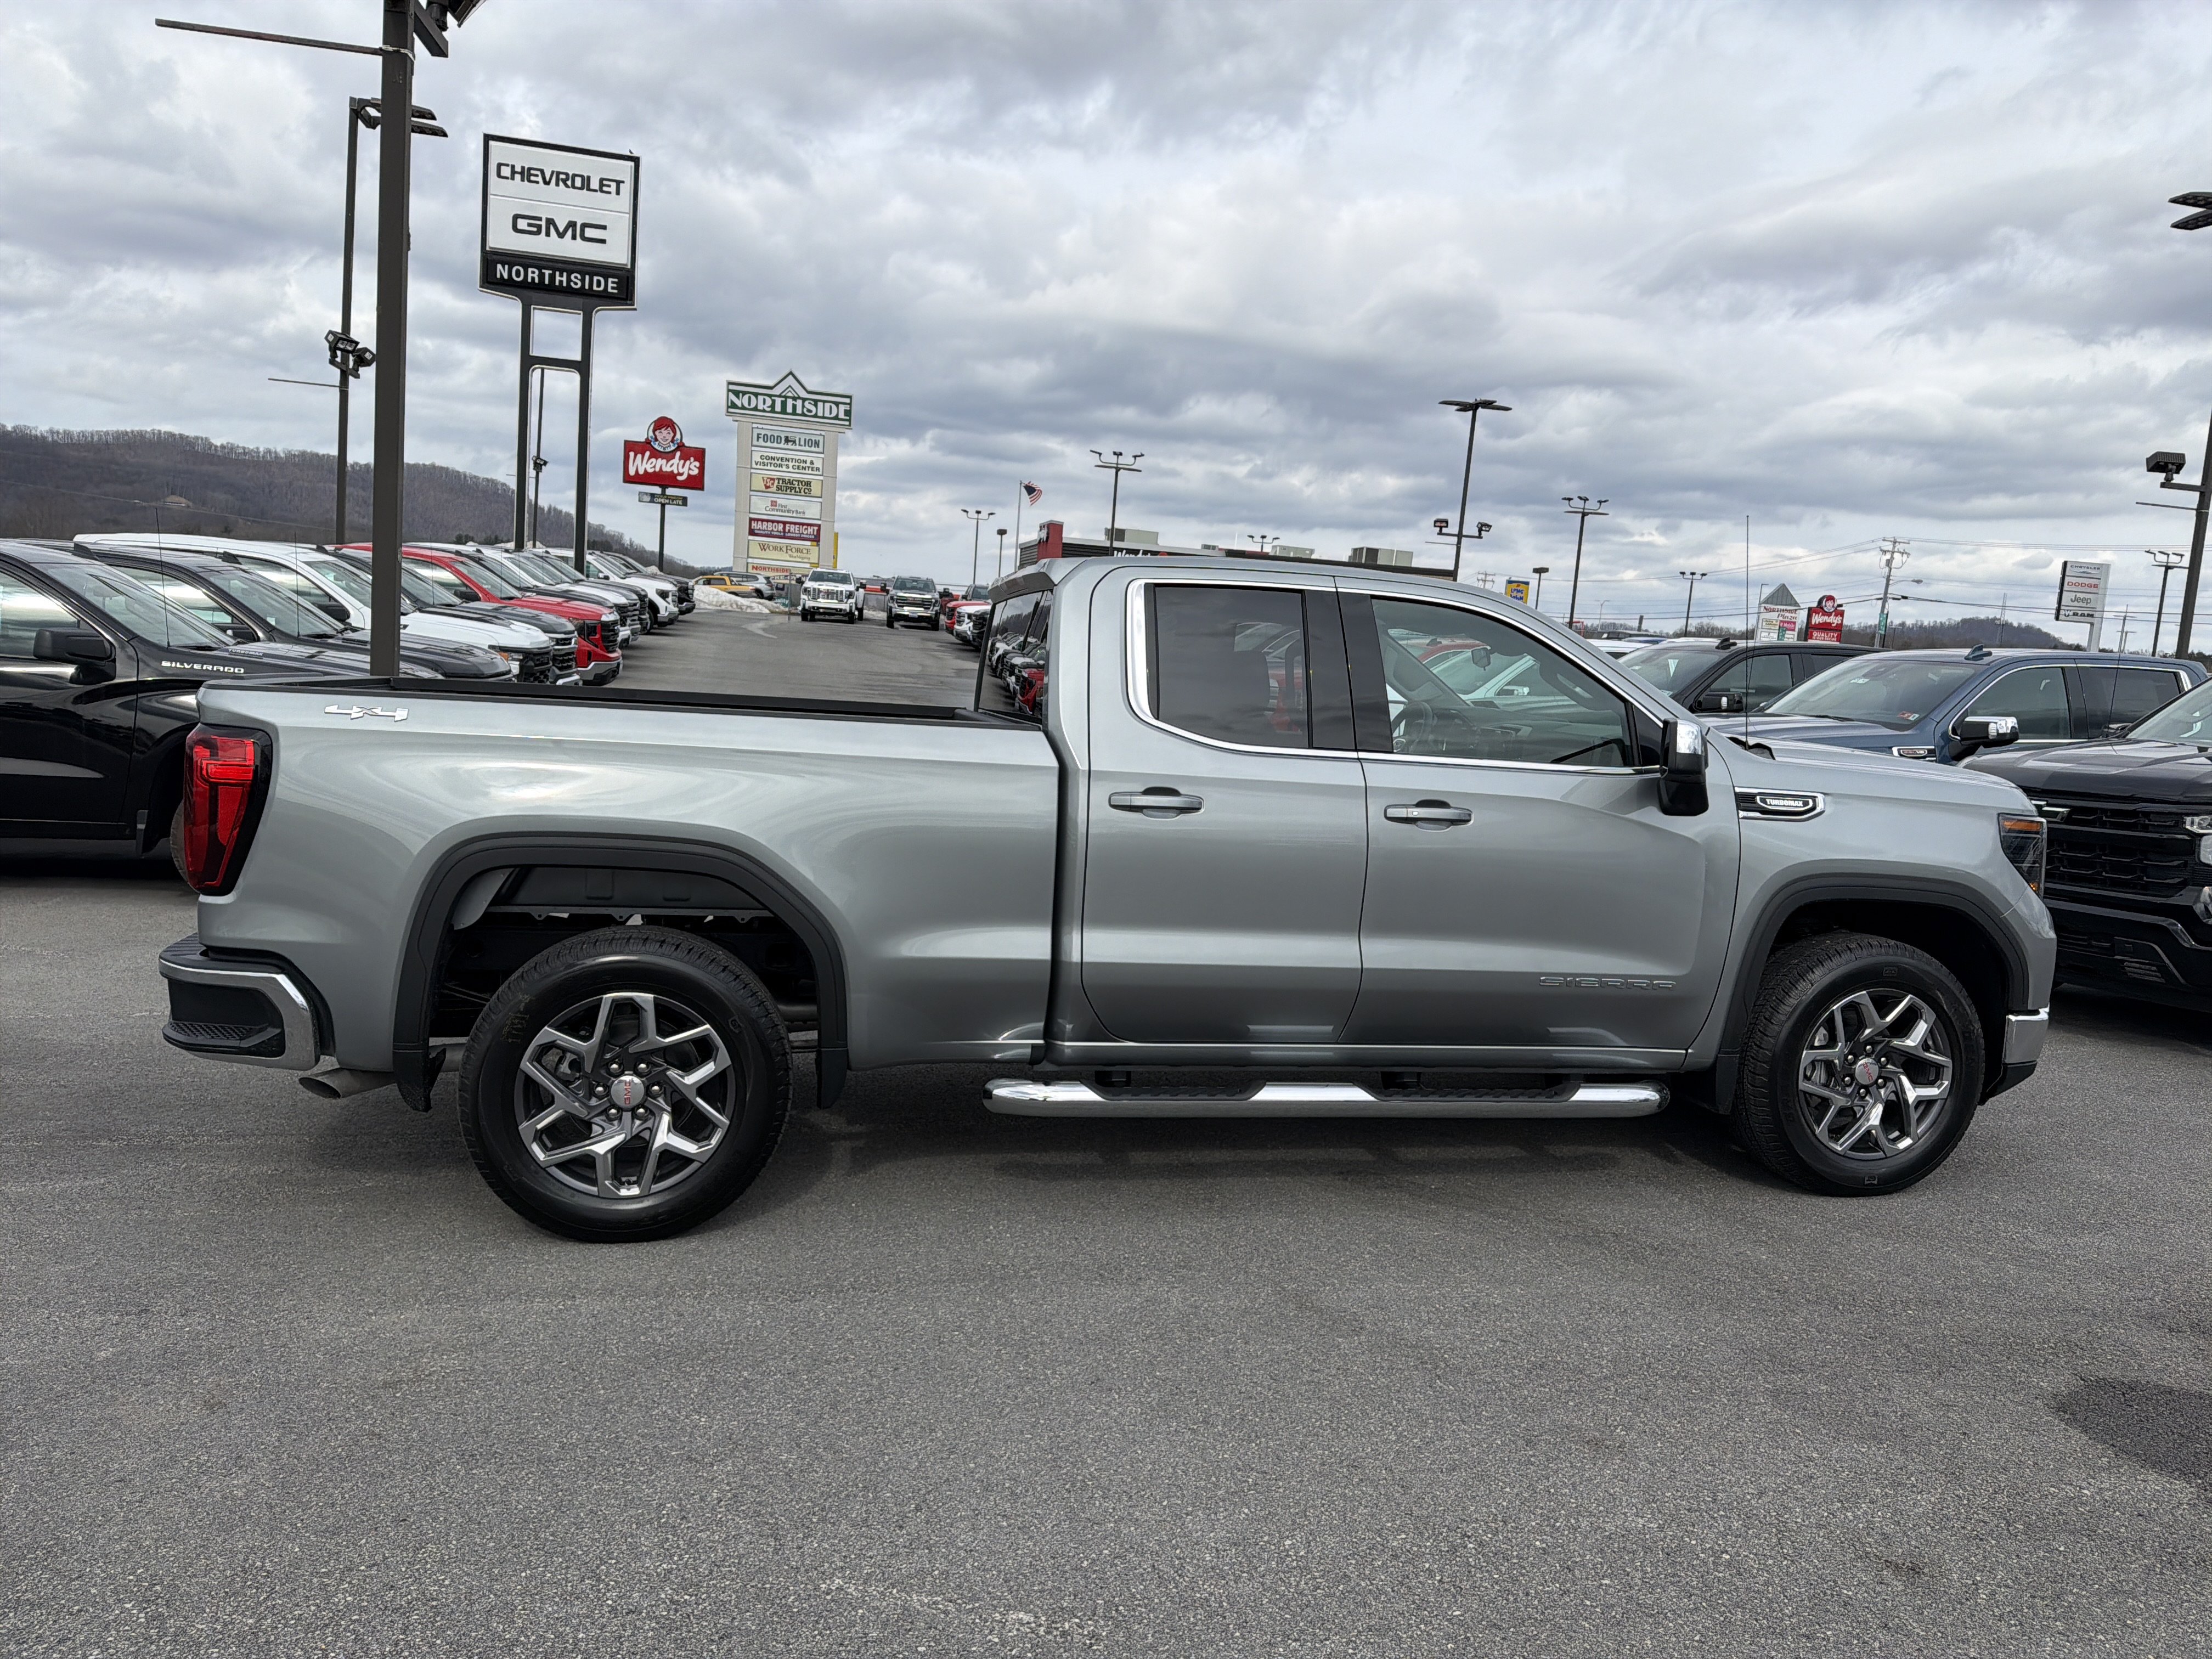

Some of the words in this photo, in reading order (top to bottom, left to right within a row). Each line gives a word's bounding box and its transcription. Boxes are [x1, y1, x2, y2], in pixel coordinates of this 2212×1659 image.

[496, 162, 625, 196] CHEVROLET
[512, 213, 607, 244] GMC
[496, 263, 618, 293] NORTHSIDE
[728, 392, 850, 419] NORTHSIDE
[757, 433, 782, 444] FOOD
[798, 437, 820, 448] LION
[628, 450, 700, 481] Wendy's
[754, 460, 790, 469] VISITOR'S
[760, 455, 807, 464] CONVENTION
[763, 478, 774, 488] TSC
[776, 477, 812, 487] TRACTOR
[776, 485, 803, 493] SUPPLY
[764, 506, 795, 515] Community
[751, 521, 783, 532] HARBOR
[785, 523, 818, 535] FREIGHT
[752, 565, 789, 573] NORTHSIDE
[2070, 594, 2092, 605] Jeep
[1763, 606, 1798, 614] NORTHSIDE
[1812, 612, 1843, 627] Wendy's
[161, 661, 244, 674] SILVERADO
[1765, 799, 1804, 807] TURBOMAX
[1539, 977, 1677, 990] SIERRA
[1863, 1063, 1874, 1082] GMC
